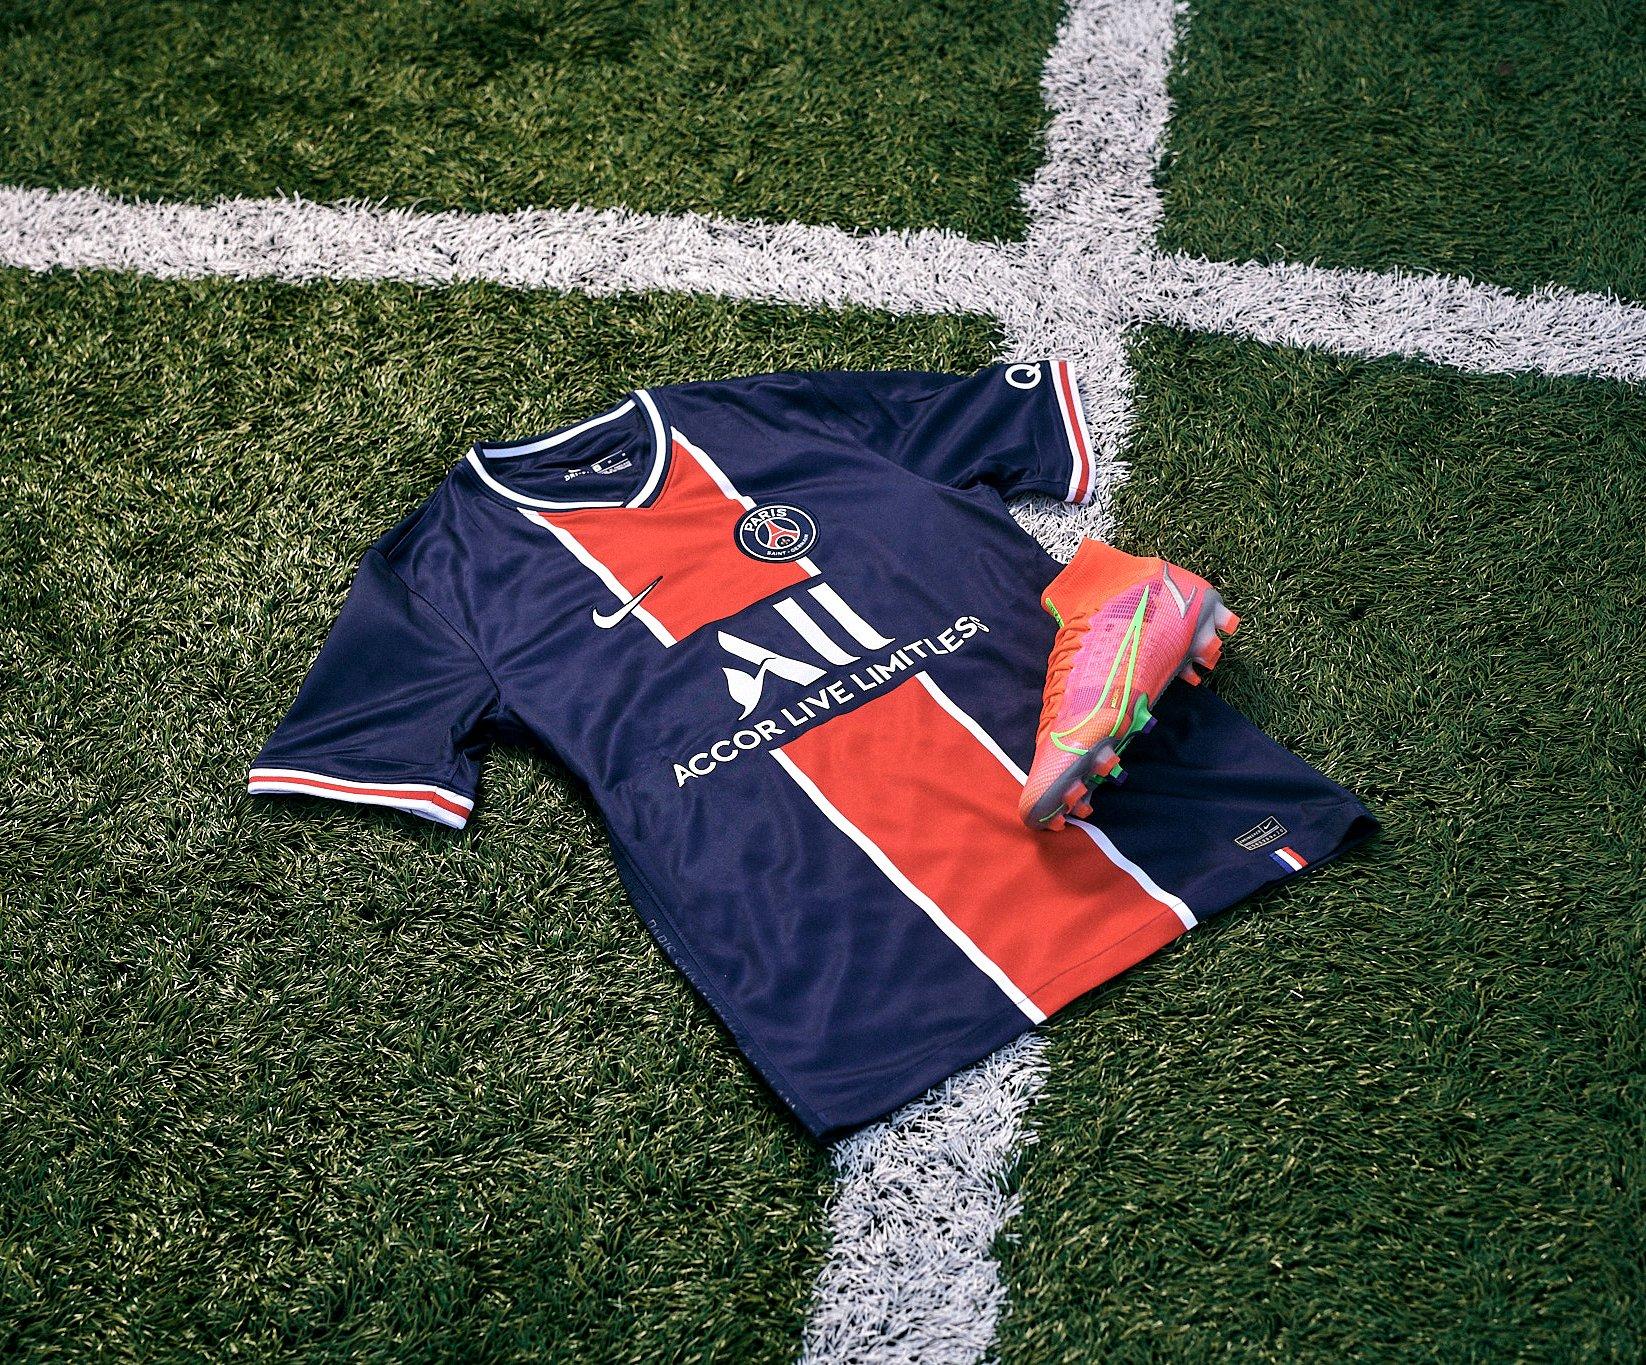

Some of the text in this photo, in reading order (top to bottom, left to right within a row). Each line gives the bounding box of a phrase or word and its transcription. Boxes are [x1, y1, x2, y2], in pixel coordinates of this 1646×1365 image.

[744, 508, 787, 531] PARIS
[673, 615, 990, 787] ACCOR LIVE LIMITLESS
